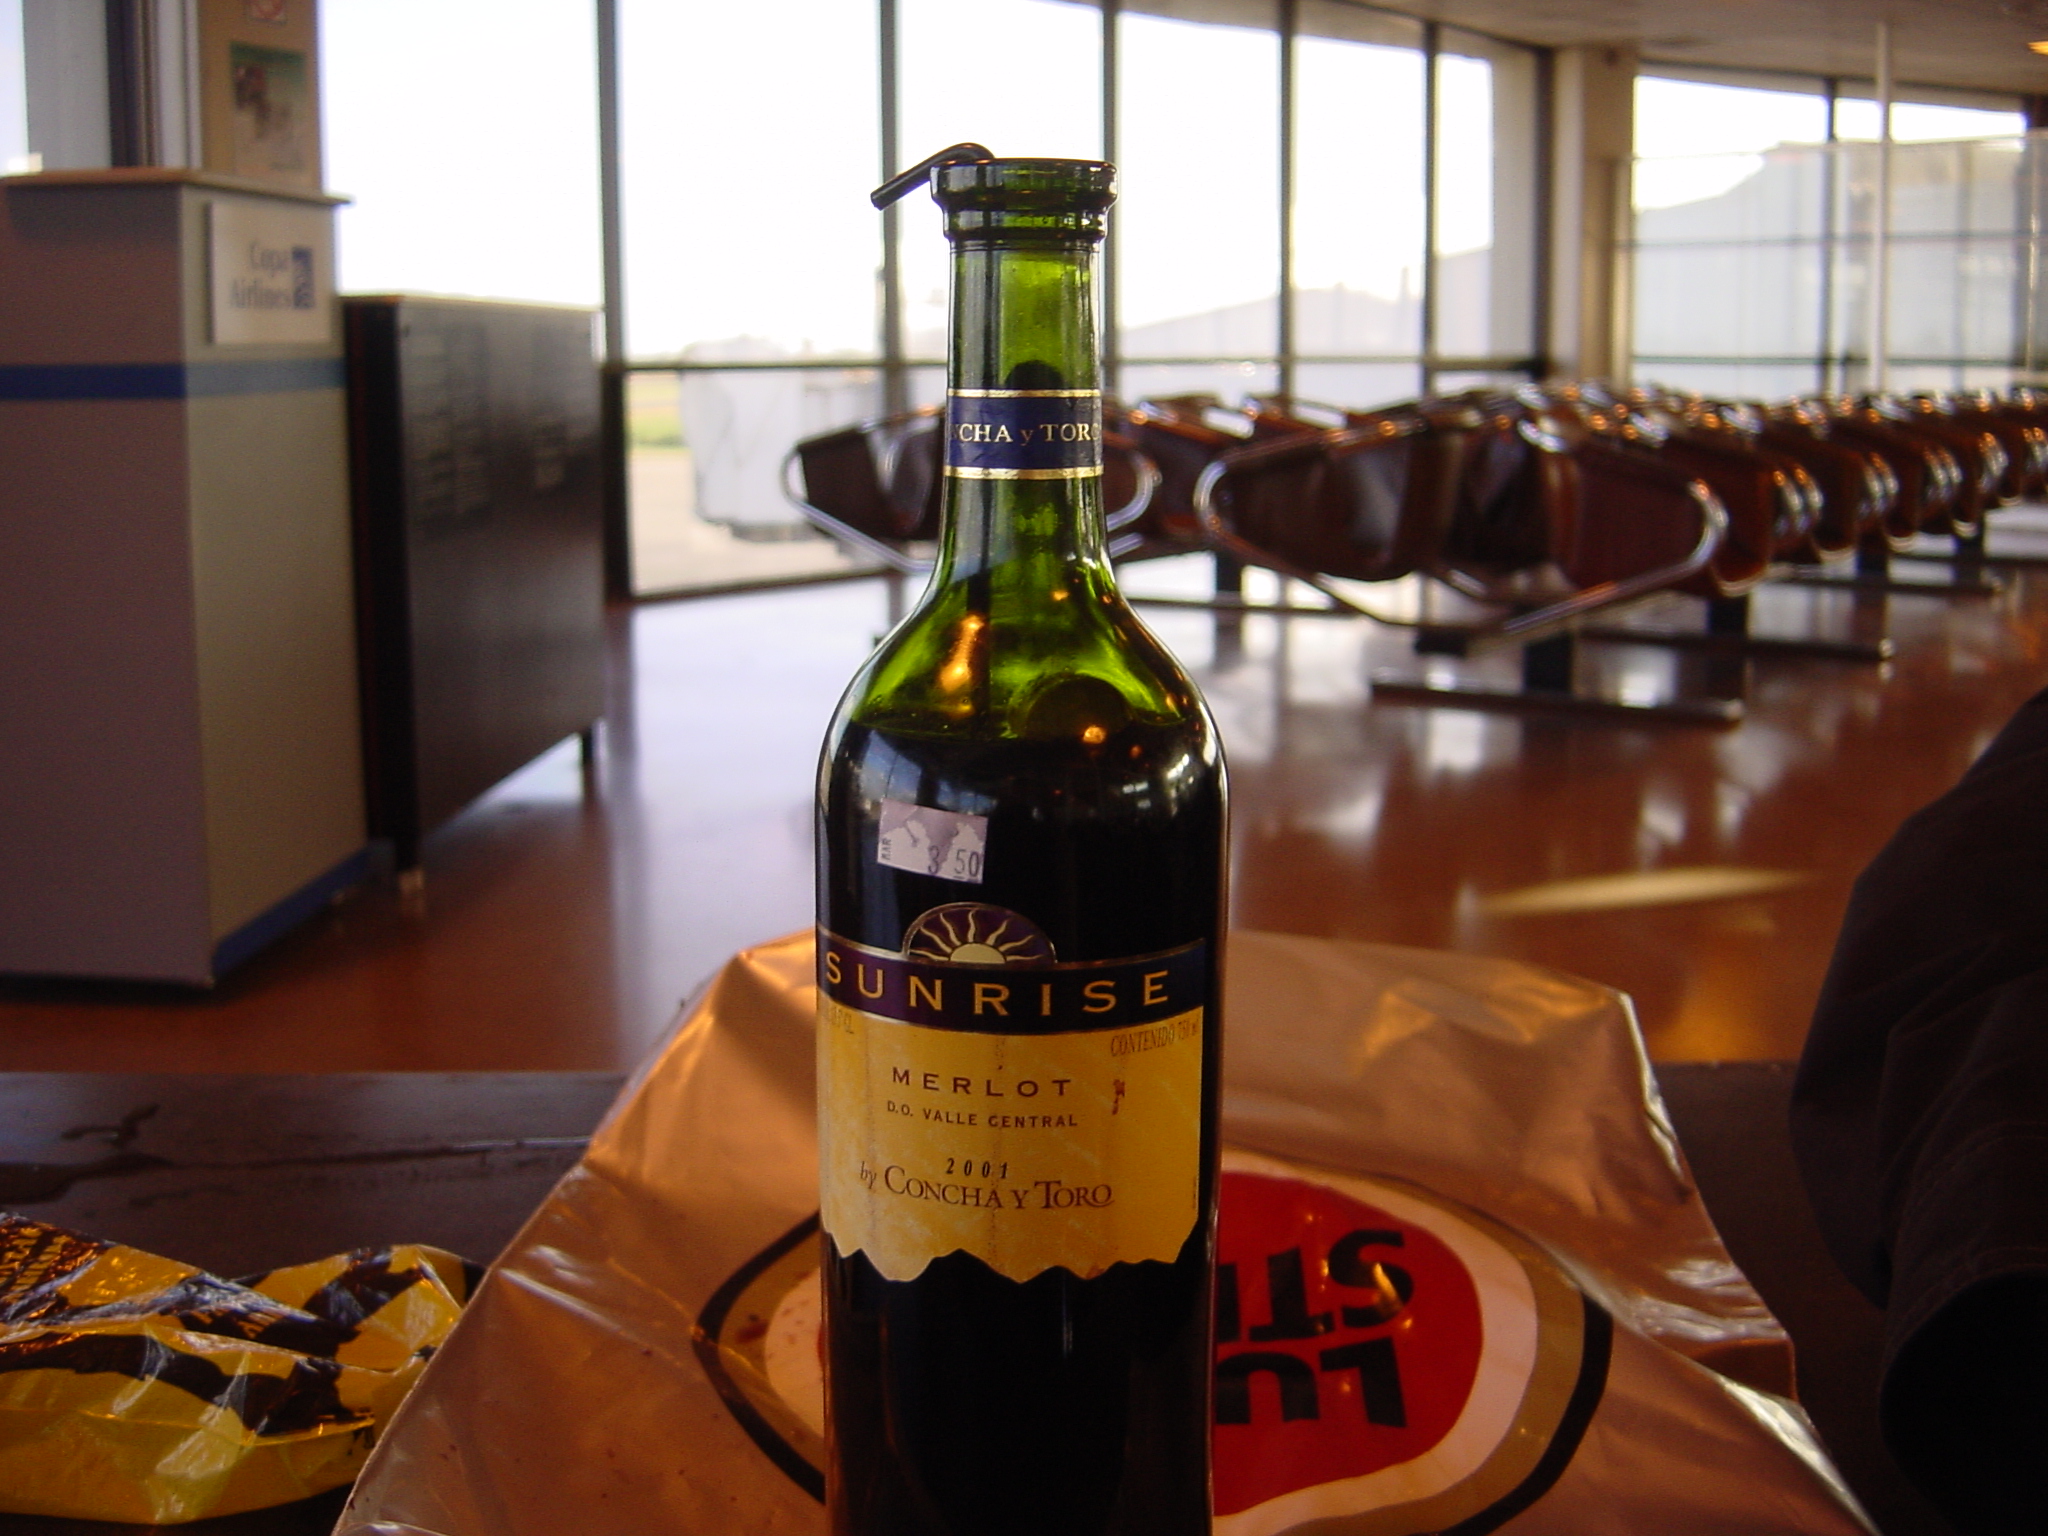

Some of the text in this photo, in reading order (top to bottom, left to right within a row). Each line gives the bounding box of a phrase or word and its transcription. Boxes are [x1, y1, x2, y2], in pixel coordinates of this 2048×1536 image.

[230, 278, 291, 312] Airlines
[1020, 430, 1034, 446] y
[825, 952, 1169, 1016] SUNRISE
[1111, 1025, 1174, 1057] CONTENIDO
[892, 1066, 1072, 1098] MERLOT
[887, 1100, 1078, 1129] D.O. VALLE CENTRAL
[860, 1160, 877, 1190] by
[946, 1157, 1008, 1180] 2001
